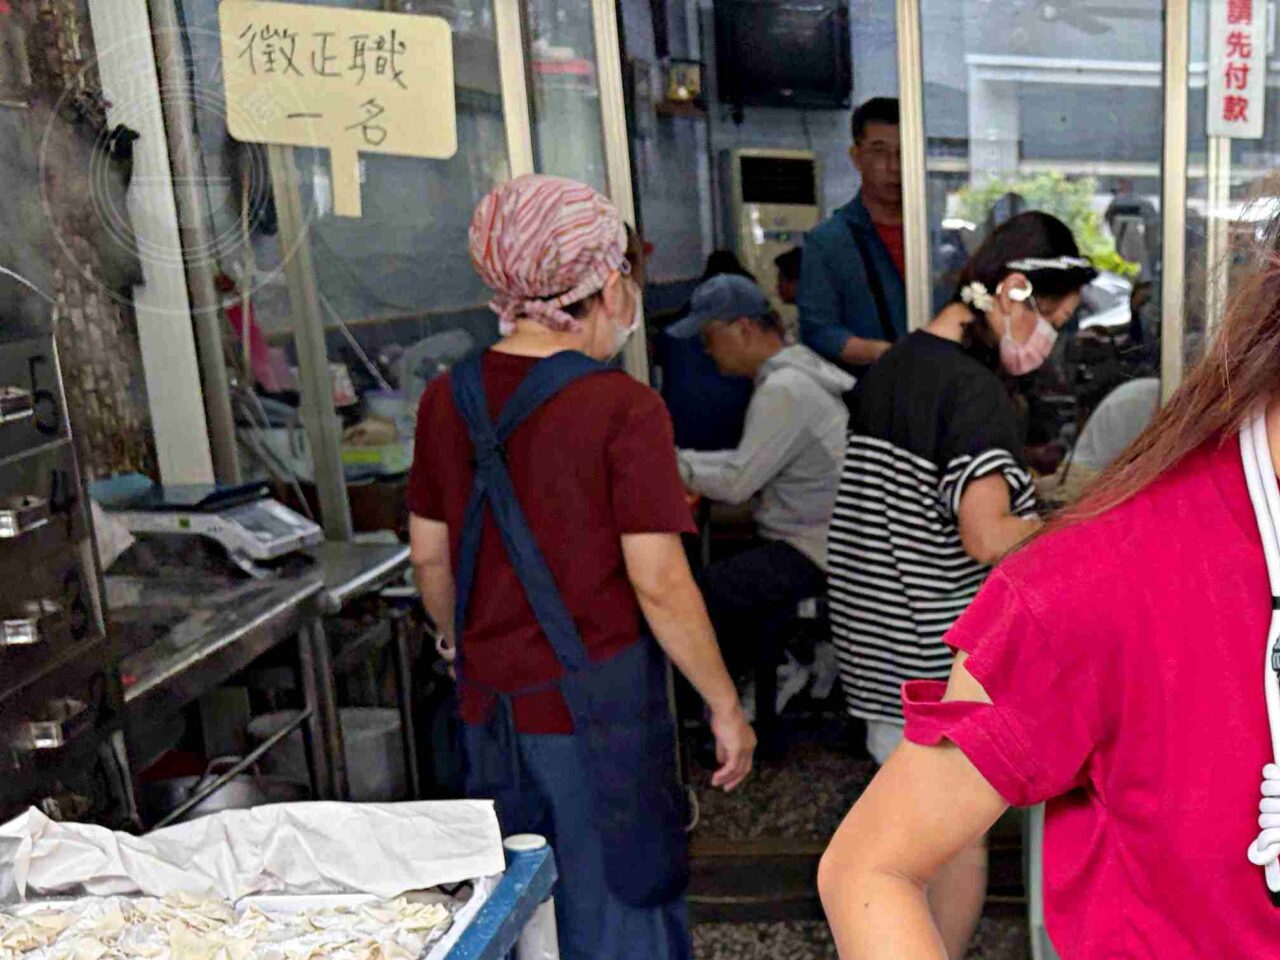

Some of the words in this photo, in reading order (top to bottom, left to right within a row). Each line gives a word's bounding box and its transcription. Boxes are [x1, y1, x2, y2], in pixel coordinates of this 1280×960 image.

[239, 24, 407, 90] 徵正職
[1222, 0, 1253, 123] 請先付款
